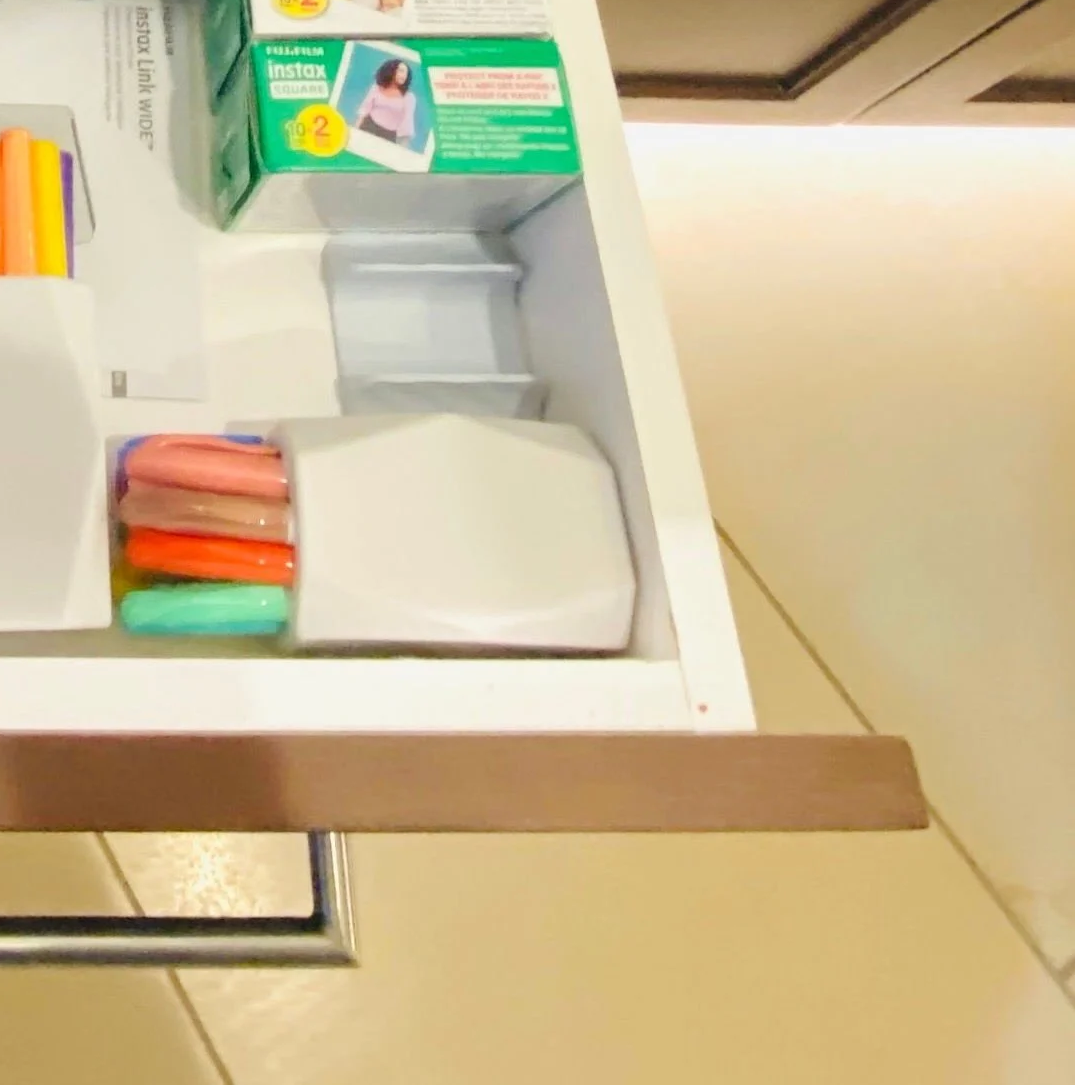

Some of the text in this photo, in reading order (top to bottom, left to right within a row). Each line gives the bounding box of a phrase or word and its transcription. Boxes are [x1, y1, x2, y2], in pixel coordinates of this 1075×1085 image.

[136, 7, 154, 54] instax
[137, 58, 156, 95] Link
[267, 58, 327, 80] instax
